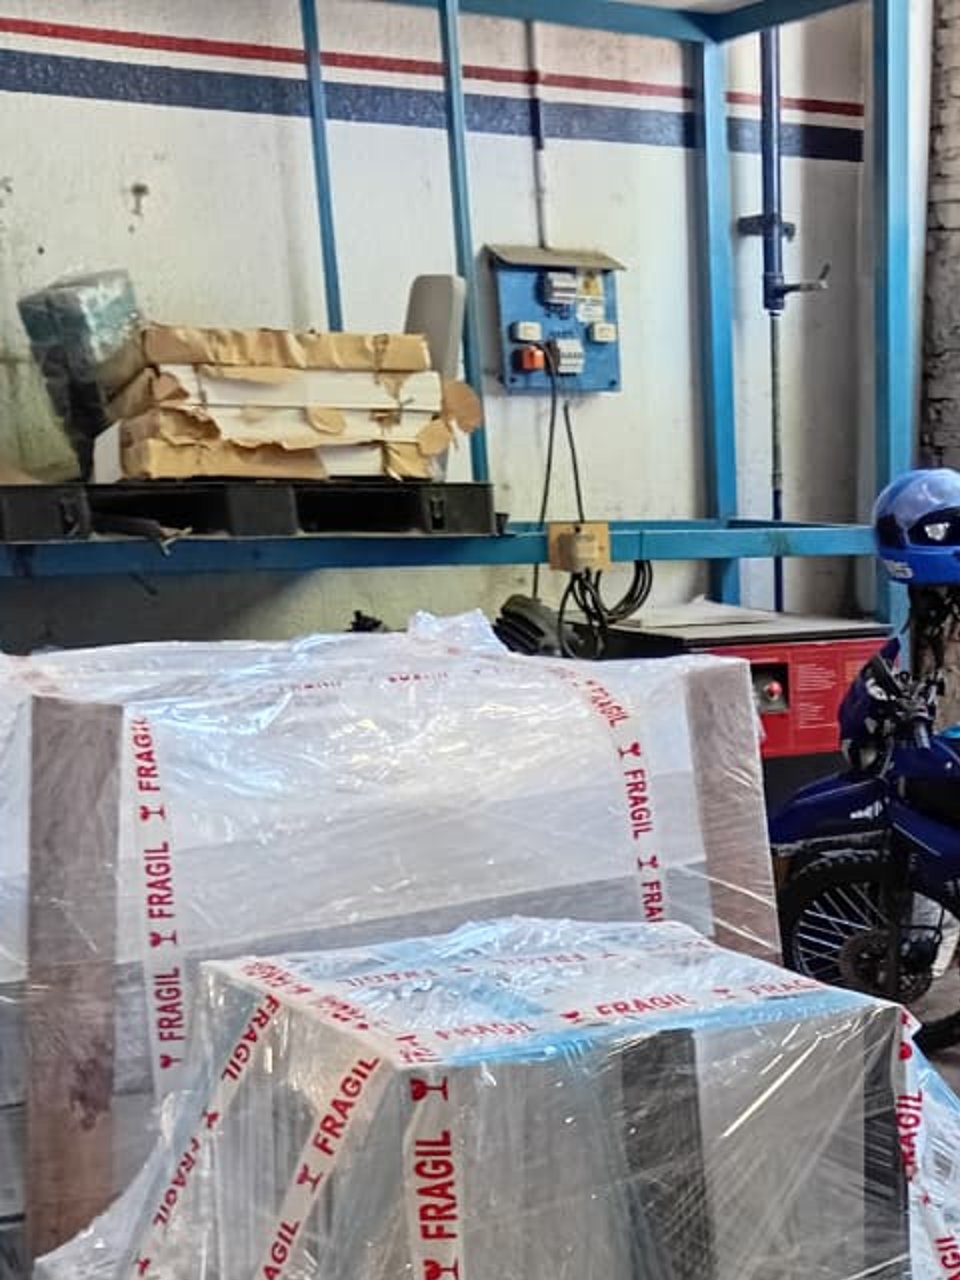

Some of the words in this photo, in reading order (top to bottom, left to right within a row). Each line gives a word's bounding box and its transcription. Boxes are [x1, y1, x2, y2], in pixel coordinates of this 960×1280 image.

[145, 841, 175, 920] FRAGIL
[623, 768, 653, 840] FRAGIL
[642, 880, 664, 922] FRA
[155, 968, 186, 1042] FRAGIL
[221, 995, 282, 1082] FRAGIL
[314, 1054, 381, 1156] FRAGIL
[414, 1129, 458, 1240] FRAGIL
